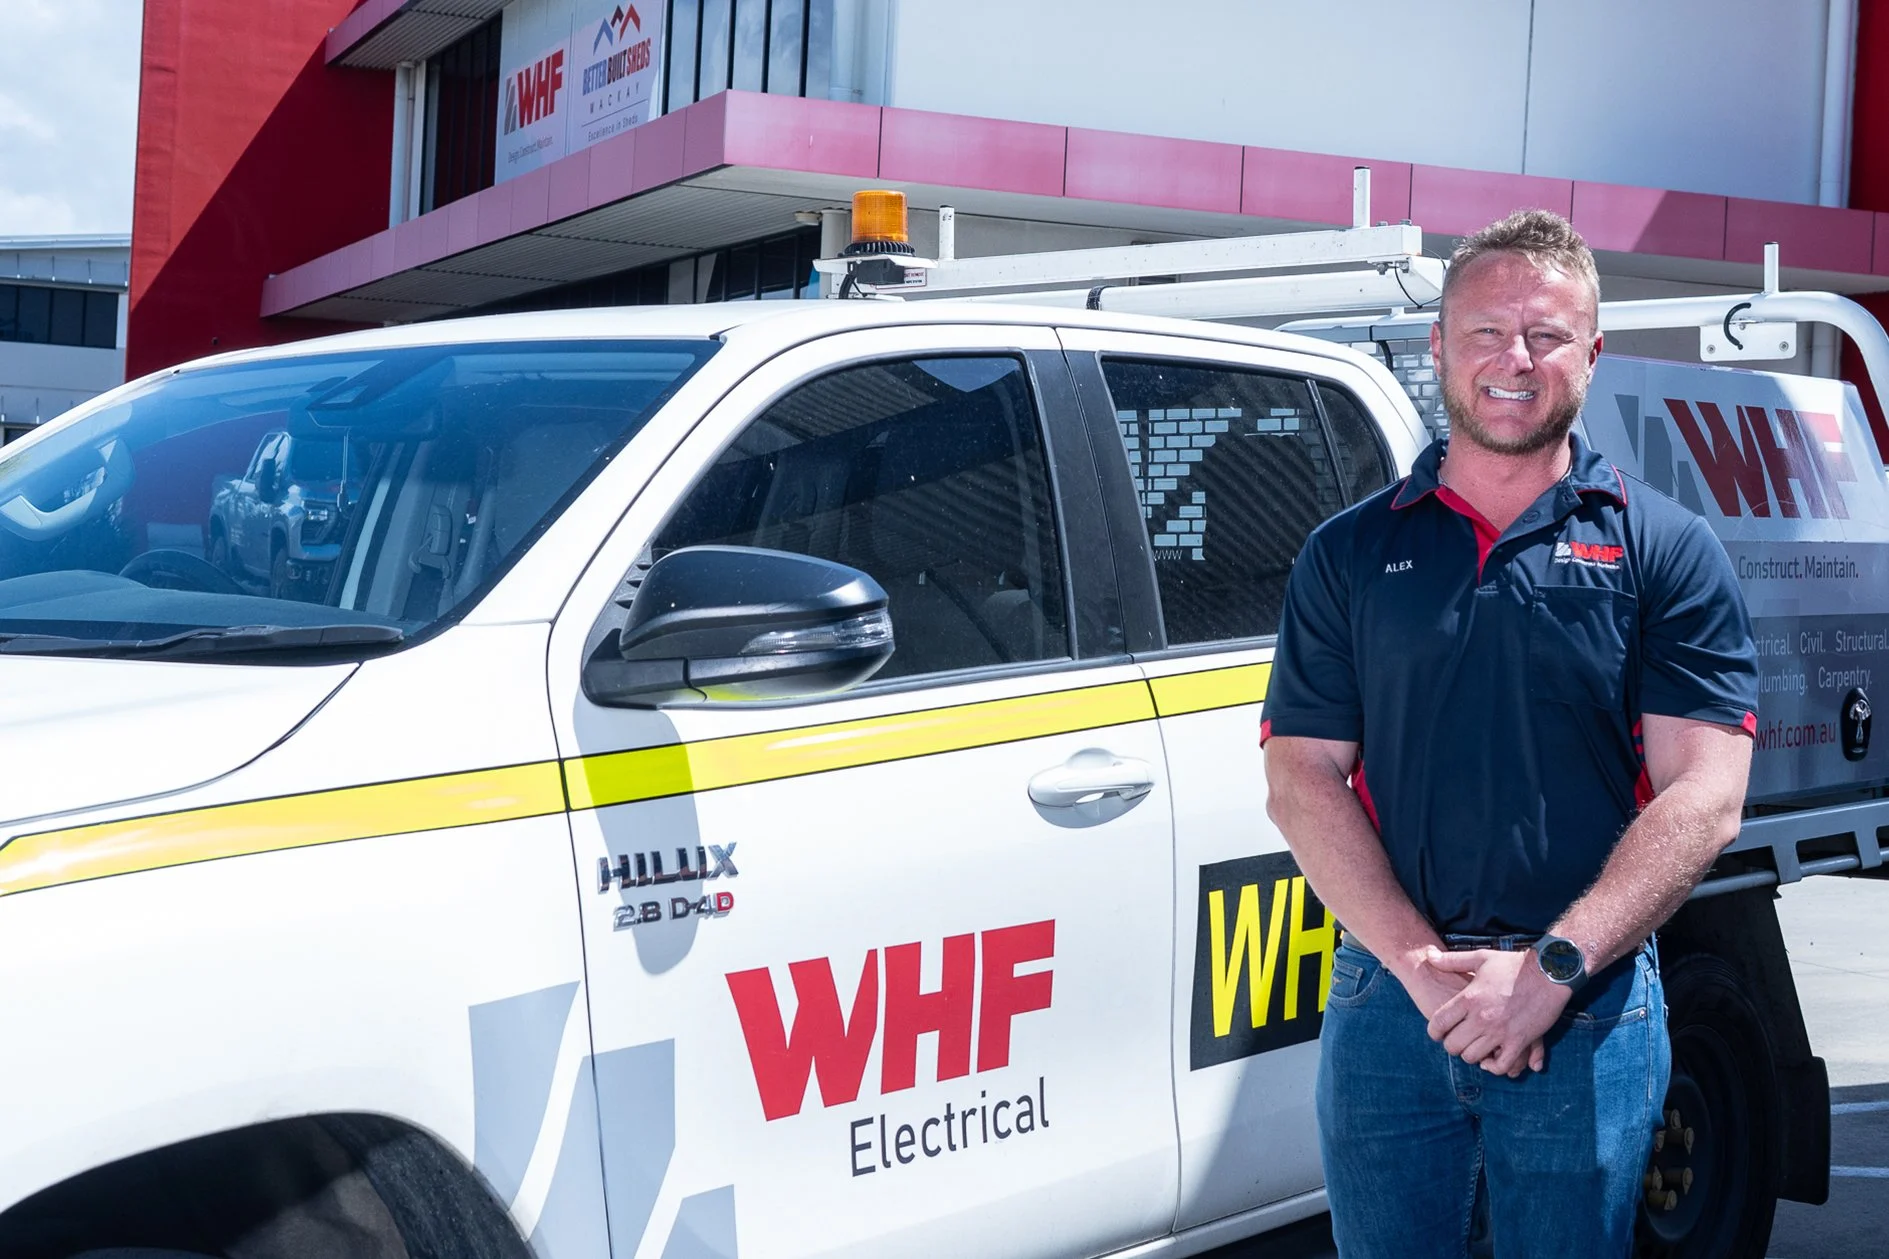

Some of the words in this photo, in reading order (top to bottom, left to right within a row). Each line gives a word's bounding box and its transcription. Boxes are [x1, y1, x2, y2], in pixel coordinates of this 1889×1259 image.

[517, 49, 564, 129] WHF
[1663, 398, 1857, 520] WHF
[1385, 559, 1414, 574] ALEX
[1570, 540, 1624, 563] WHF
[1738, 555, 1802, 579] Construct.
[1804, 554, 1859, 579] Maintain.
[1755, 632, 1793, 657] ctrical.
[1800, 632, 1826, 655] Civil.
[1760, 667, 1808, 696] lumbing.
[1818, 665, 1873, 692] Carpentry.
[1752, 720, 1836, 752] .whf.com.au
[597, 842, 739, 894] HILUX
[613, 901, 662, 932] 2.8
[669, 891, 735, 920] D-4D
[1208, 875, 1336, 1038] WH
[725, 918, 1056, 1122] WHF
[850, 1076, 1050, 1177] Electrical
